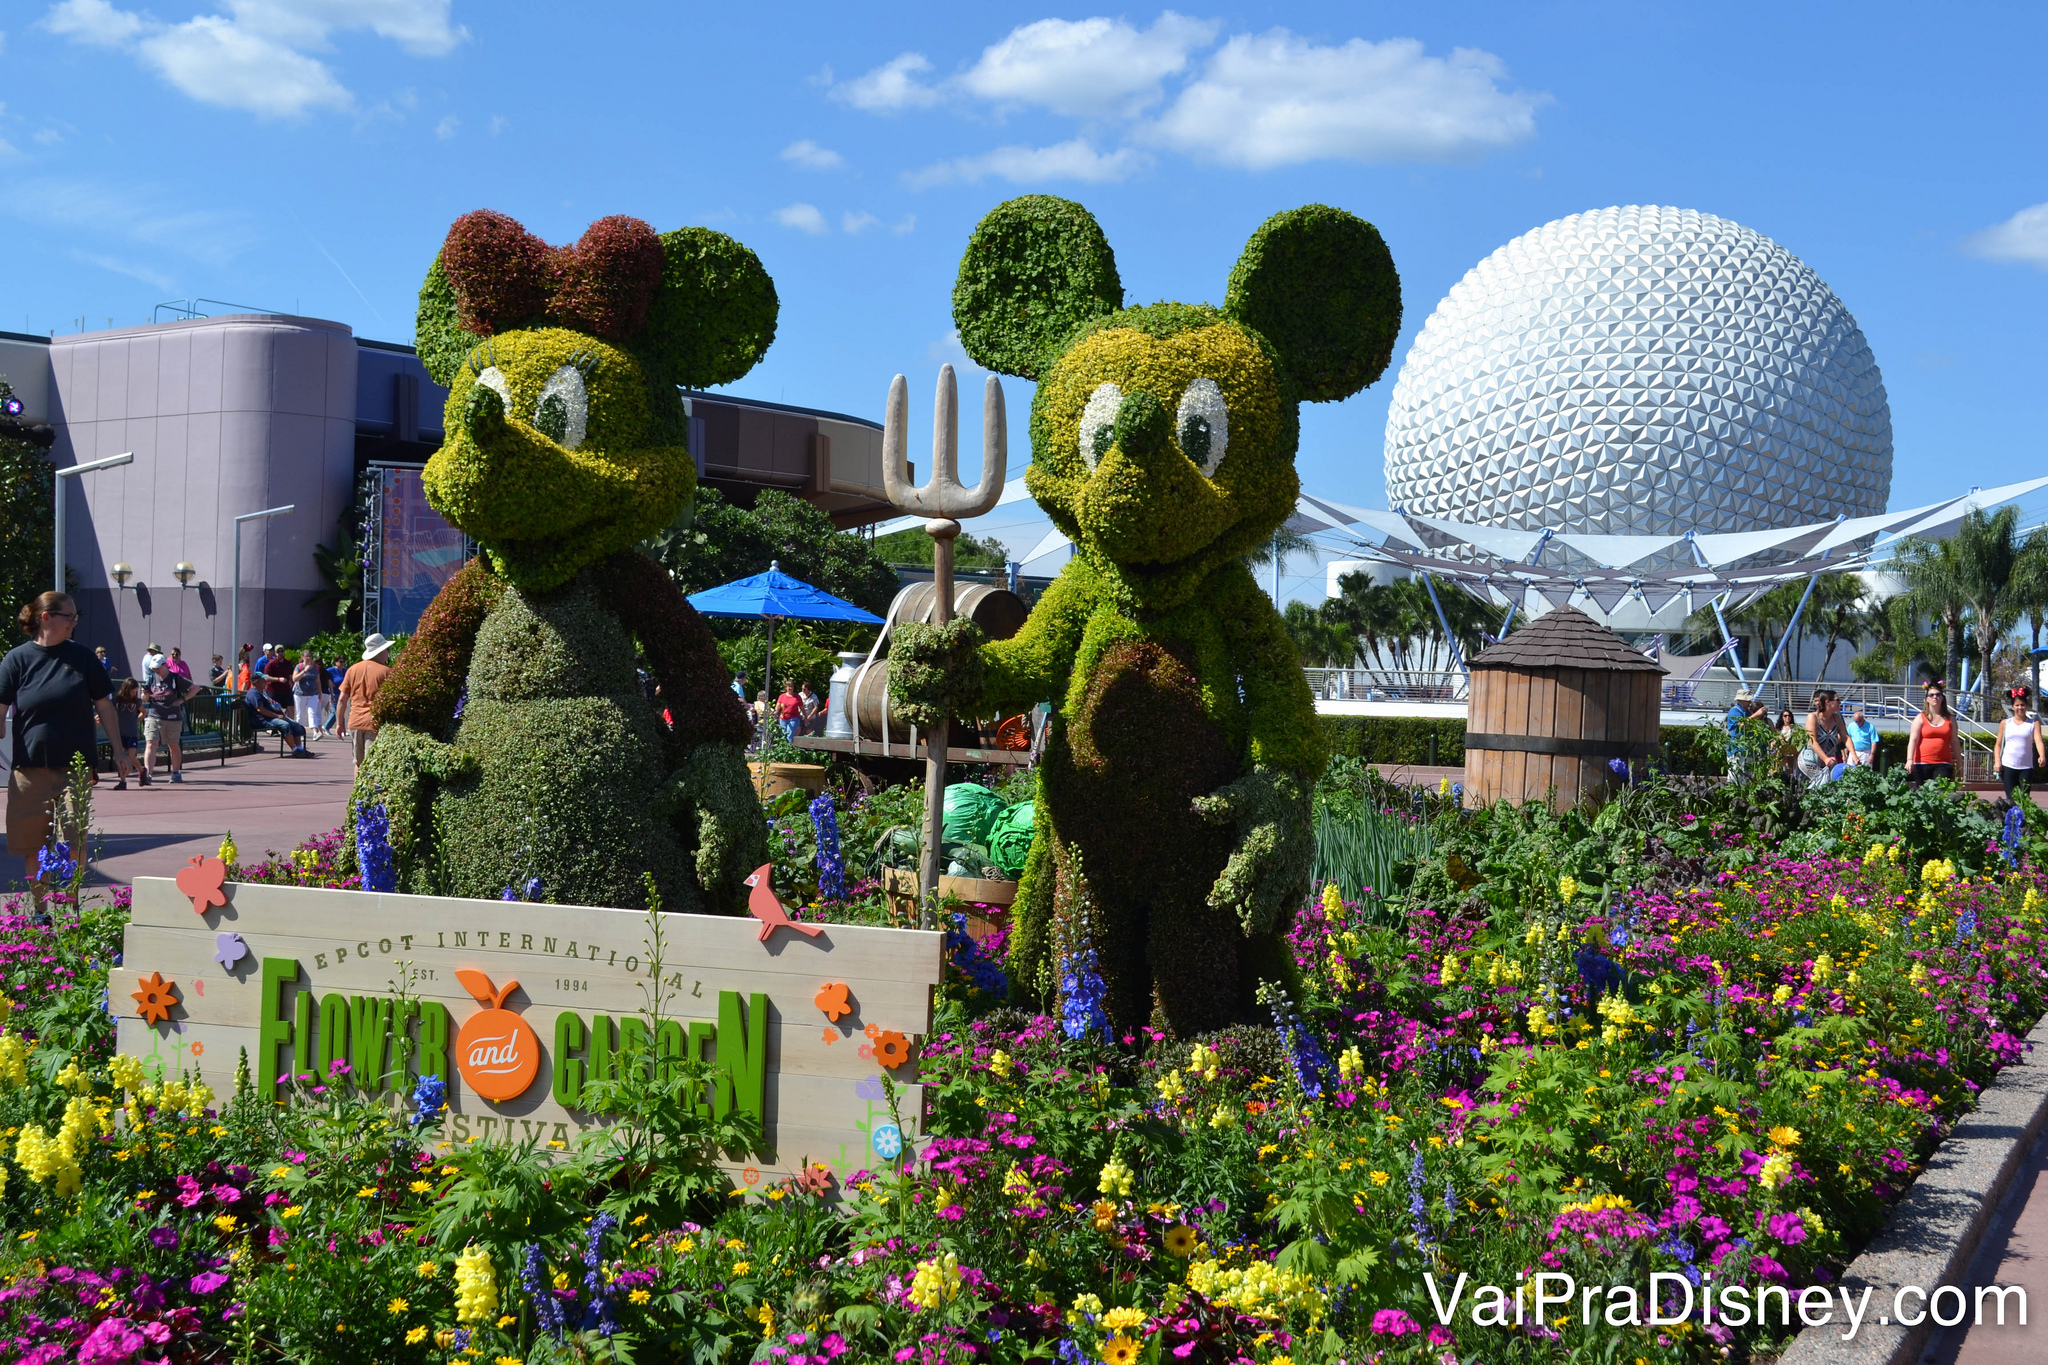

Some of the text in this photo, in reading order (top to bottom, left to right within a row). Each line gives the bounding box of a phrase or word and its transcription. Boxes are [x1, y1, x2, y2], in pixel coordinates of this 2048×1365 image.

[314, 930, 703, 999] EPCOT INTERNATIONAL
[412, 968, 588, 992] EST. 1994
[468, 1028, 519, 1067] and
